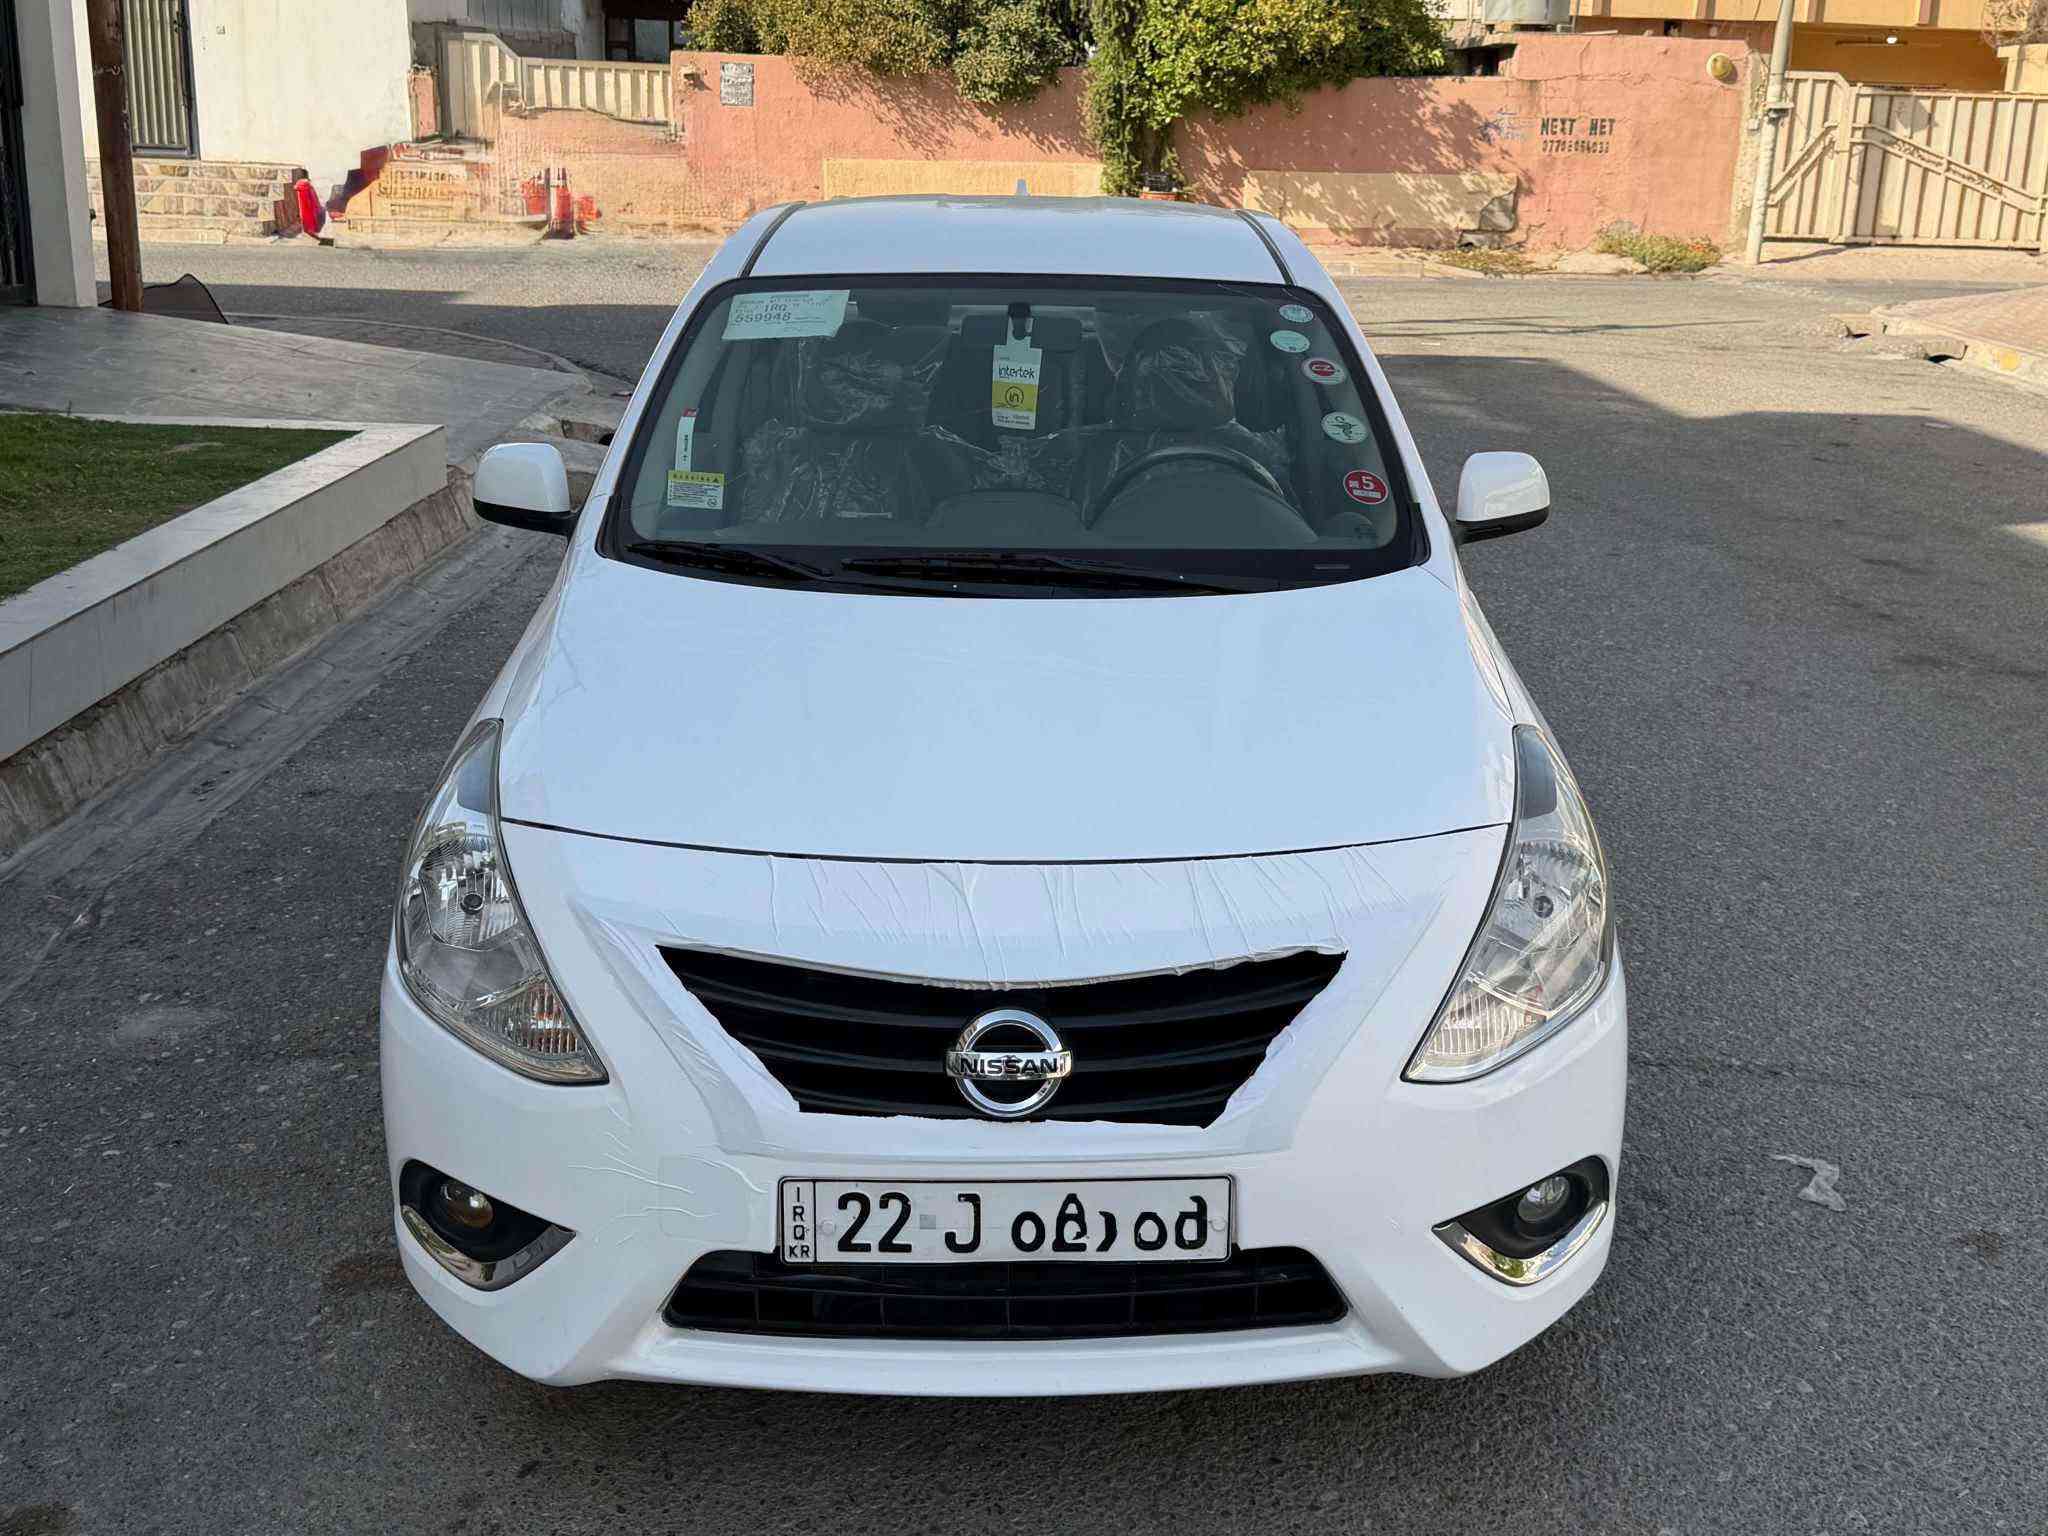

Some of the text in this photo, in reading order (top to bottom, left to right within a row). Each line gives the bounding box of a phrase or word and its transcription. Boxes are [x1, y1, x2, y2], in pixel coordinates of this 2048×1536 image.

[1540, 117, 1576, 136] NEXT
[1589, 118, 1616, 136] NET
[1361, 475, 1375, 490] 5
[960, 1058, 1058, 1075] NISSAN
[837, 1191, 913, 1253] 22
[944, 1193, 981, 1253] J
[789, 1244, 810, 1259] KR
